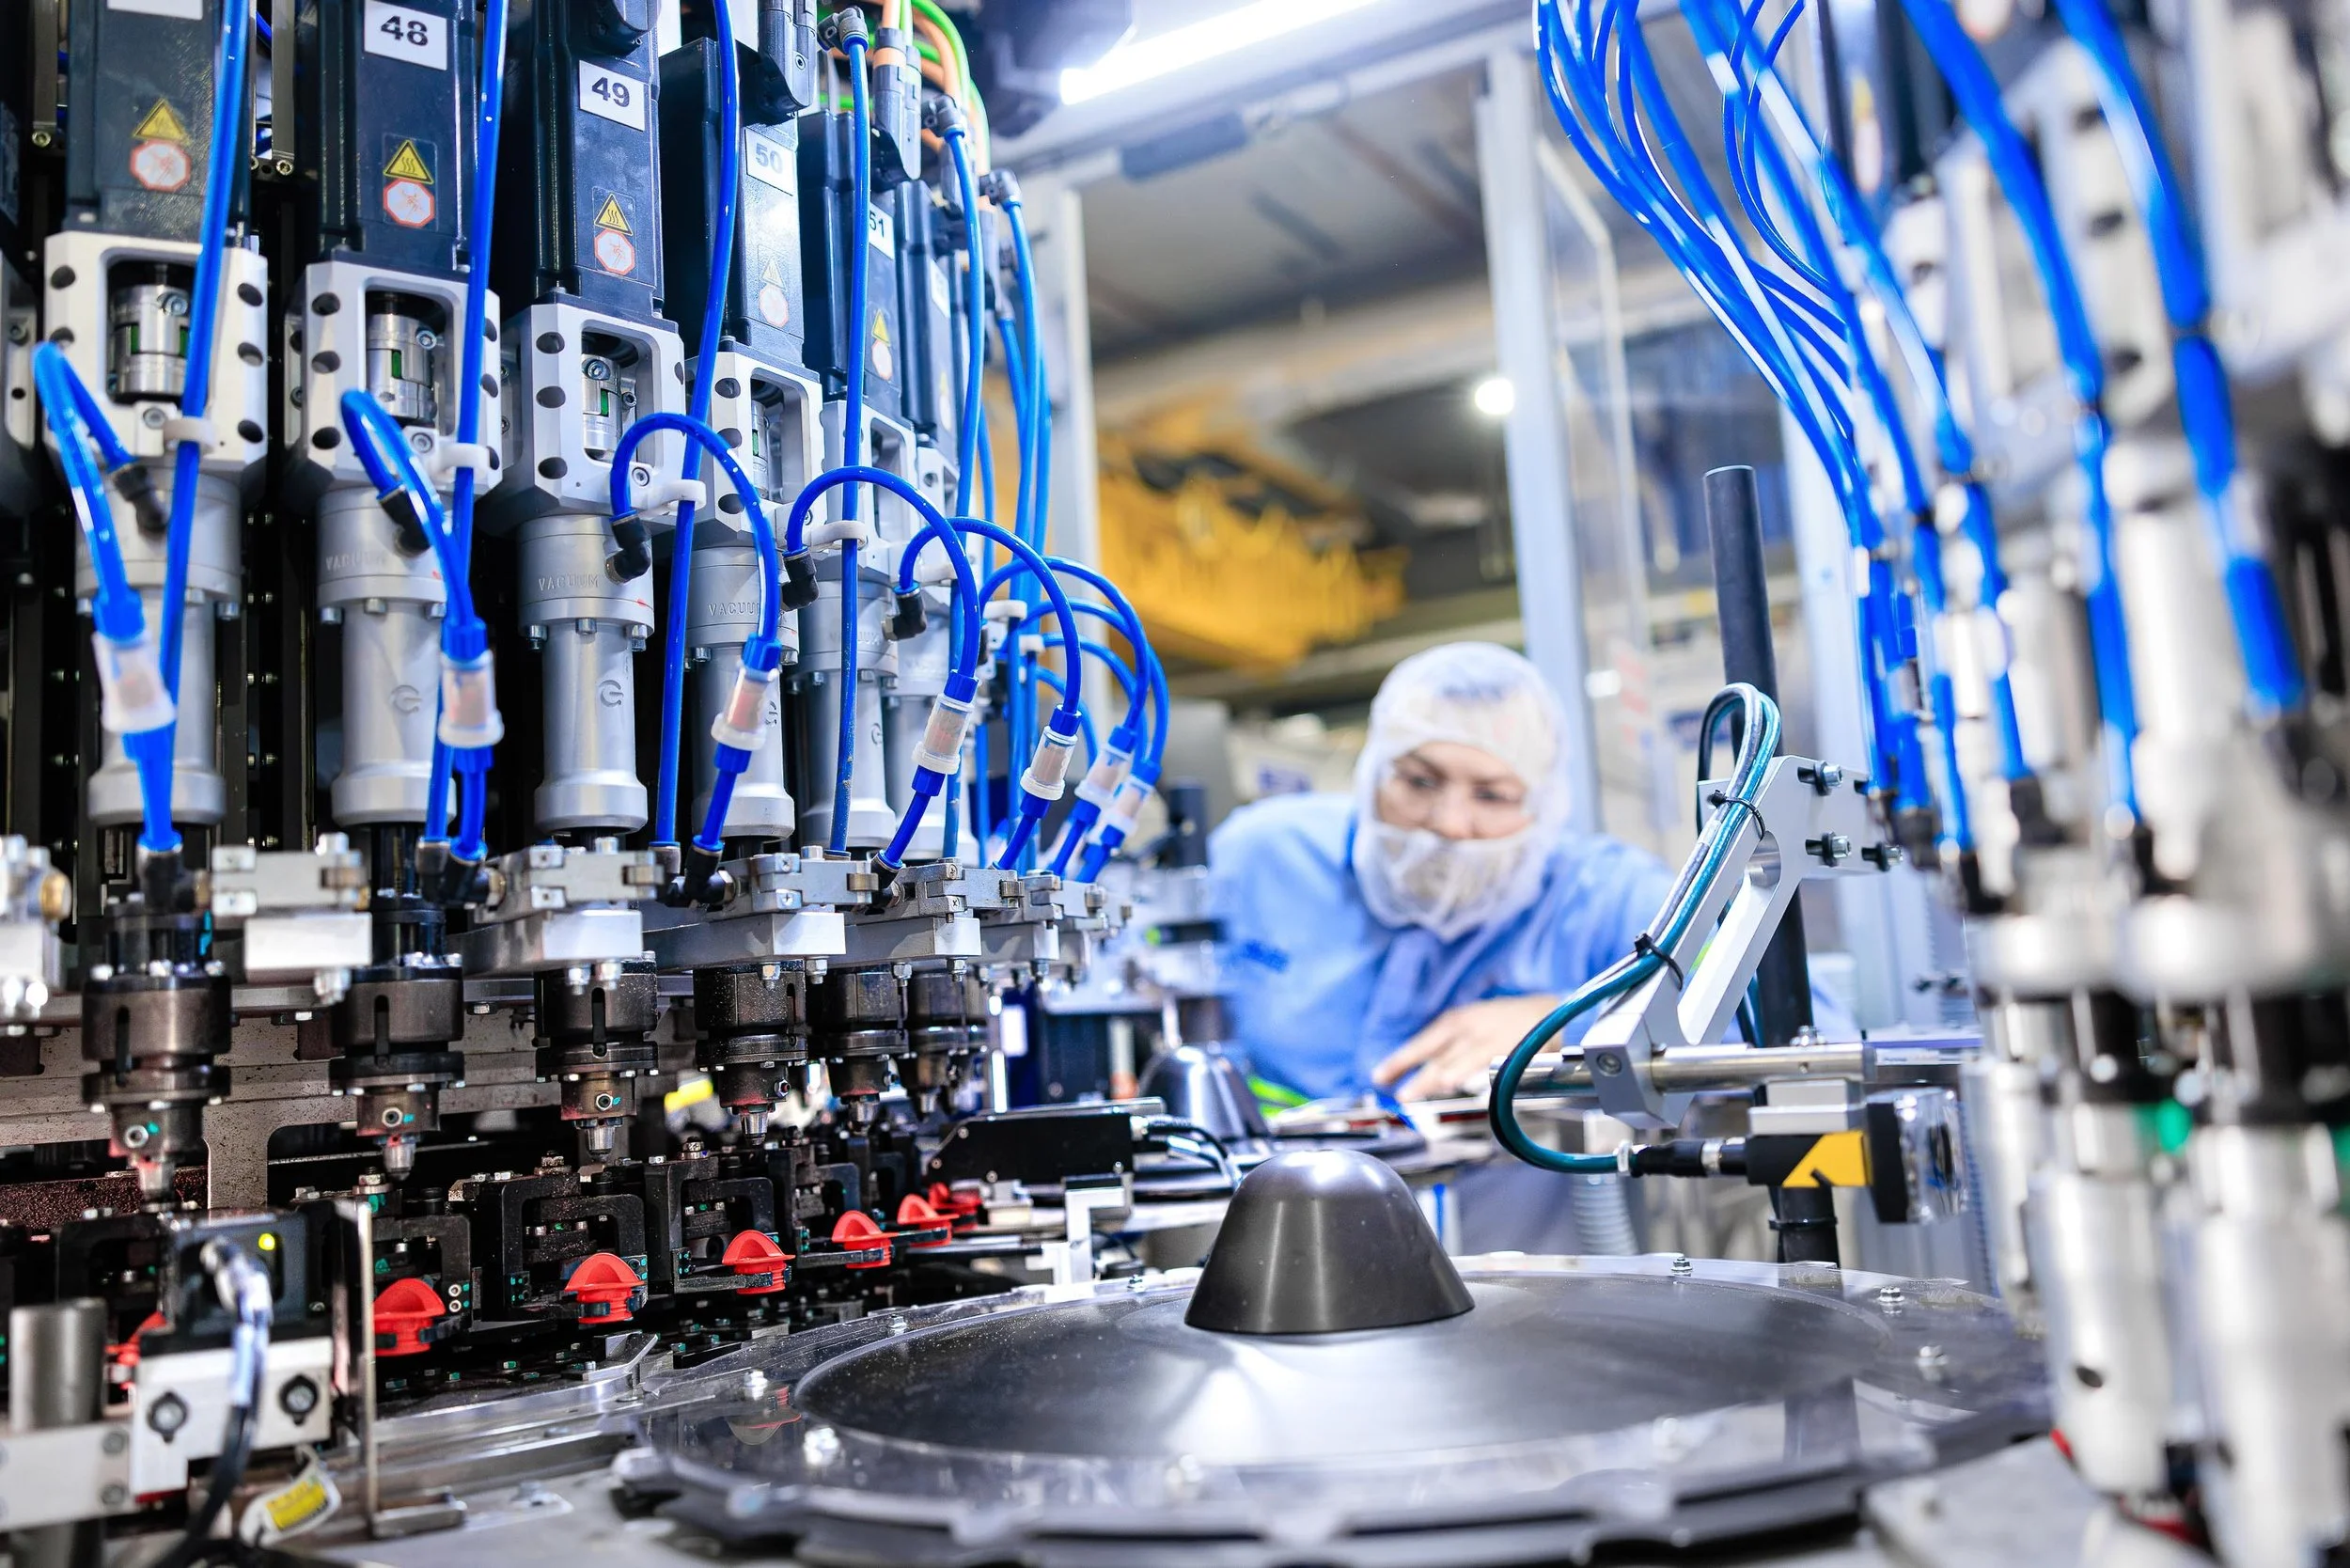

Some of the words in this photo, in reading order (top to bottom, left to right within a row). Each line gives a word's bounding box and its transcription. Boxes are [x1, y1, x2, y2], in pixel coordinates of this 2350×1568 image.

[381, 15, 428, 46] 48
[591, 76, 630, 108] 49
[755, 142, 782, 174] 50
[870, 210, 885, 238] 51
[538, 573, 599, 590] VACUUM
[708, 602, 760, 617] VACUU
